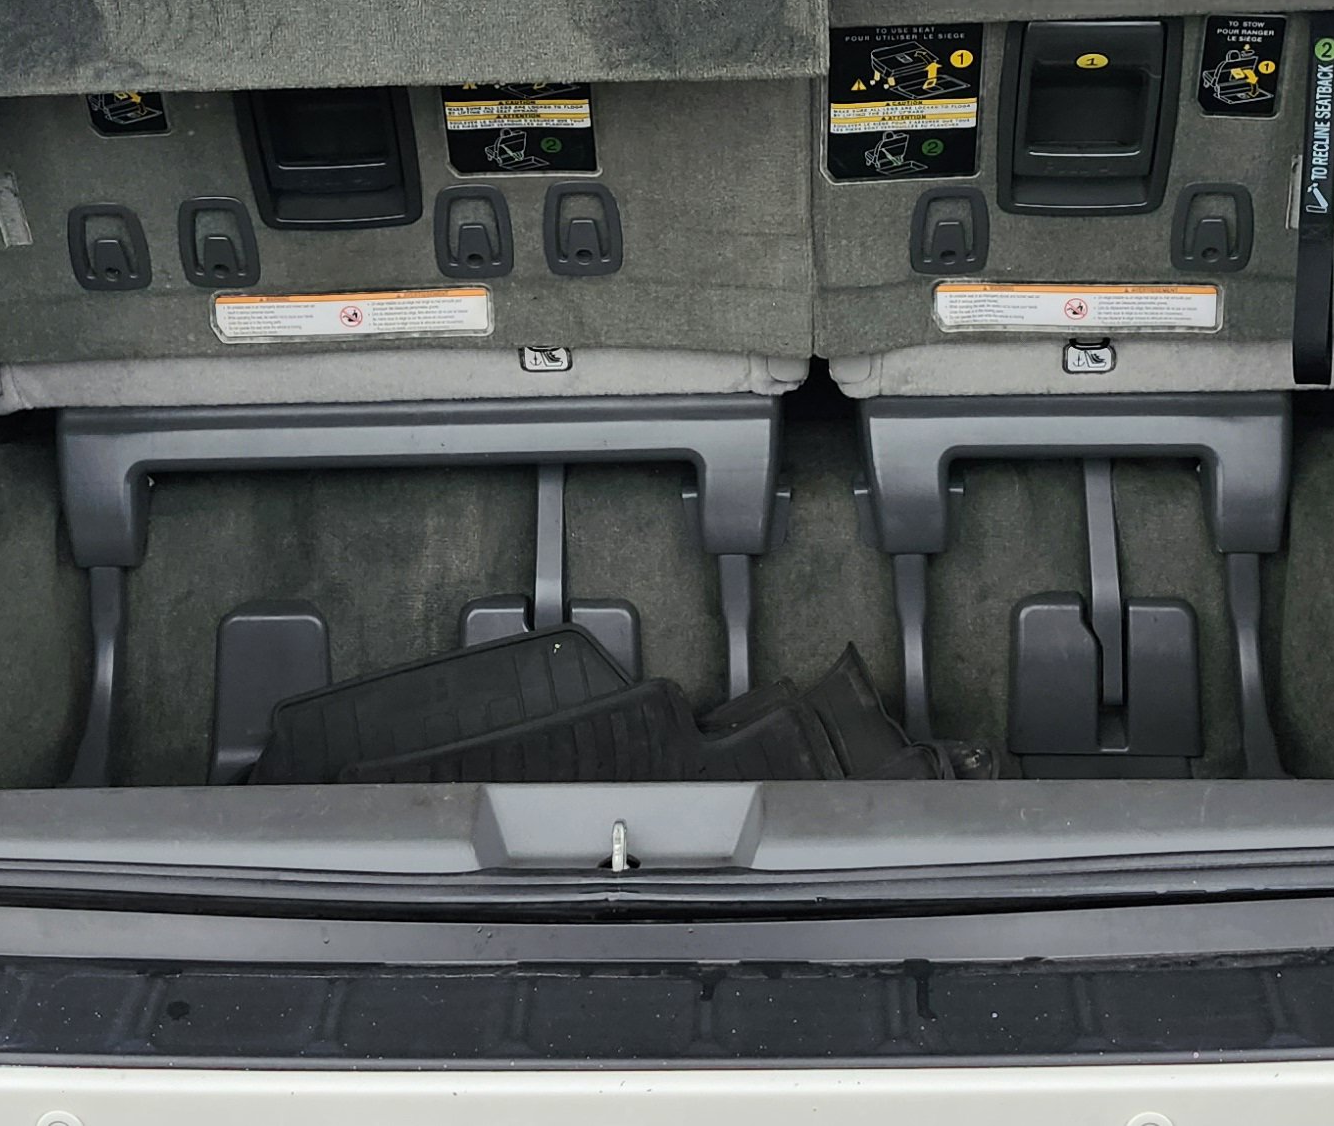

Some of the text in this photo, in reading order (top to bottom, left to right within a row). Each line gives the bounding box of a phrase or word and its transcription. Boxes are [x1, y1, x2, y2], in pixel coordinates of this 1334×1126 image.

[845, 34, 870, 42] POUR
[1310, 64, 1334, 180] TO RECLINE SEATBACK
